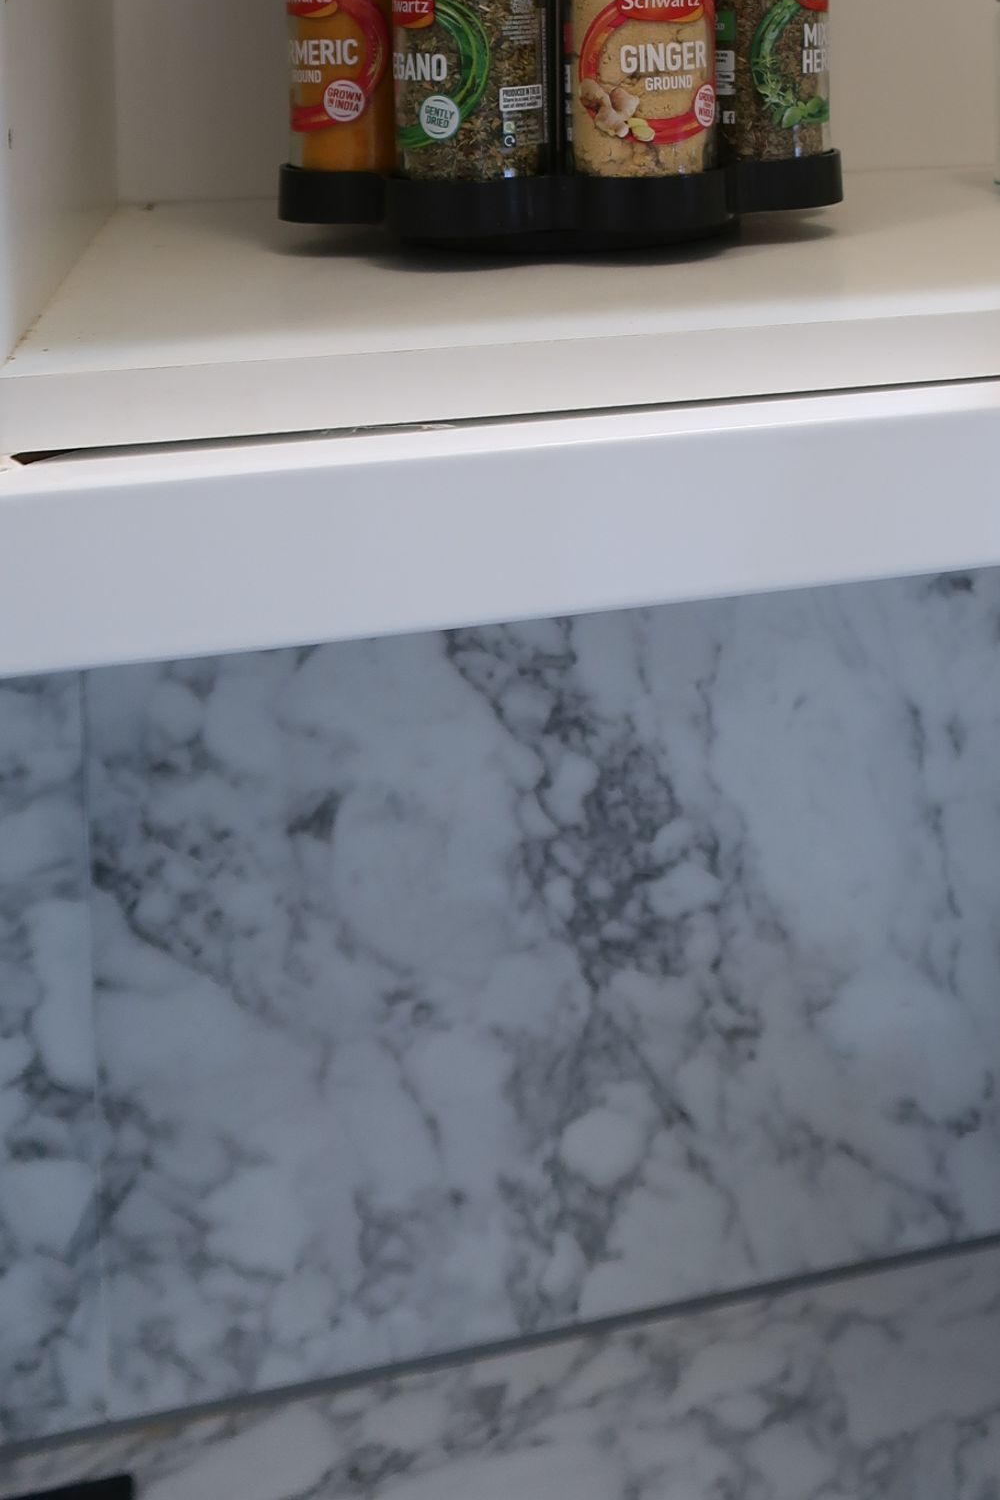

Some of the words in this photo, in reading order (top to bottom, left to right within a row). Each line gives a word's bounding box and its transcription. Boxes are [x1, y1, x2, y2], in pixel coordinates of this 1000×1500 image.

[620, 40, 707, 74] GINGER
[645, 75, 693, 91] GROUND
[327, 87, 362, 103] GROWN
[335, 99, 360, 113] INDIA
[425, 105, 455, 120] GENTLY
[426, 115, 450, 129] DRIED
